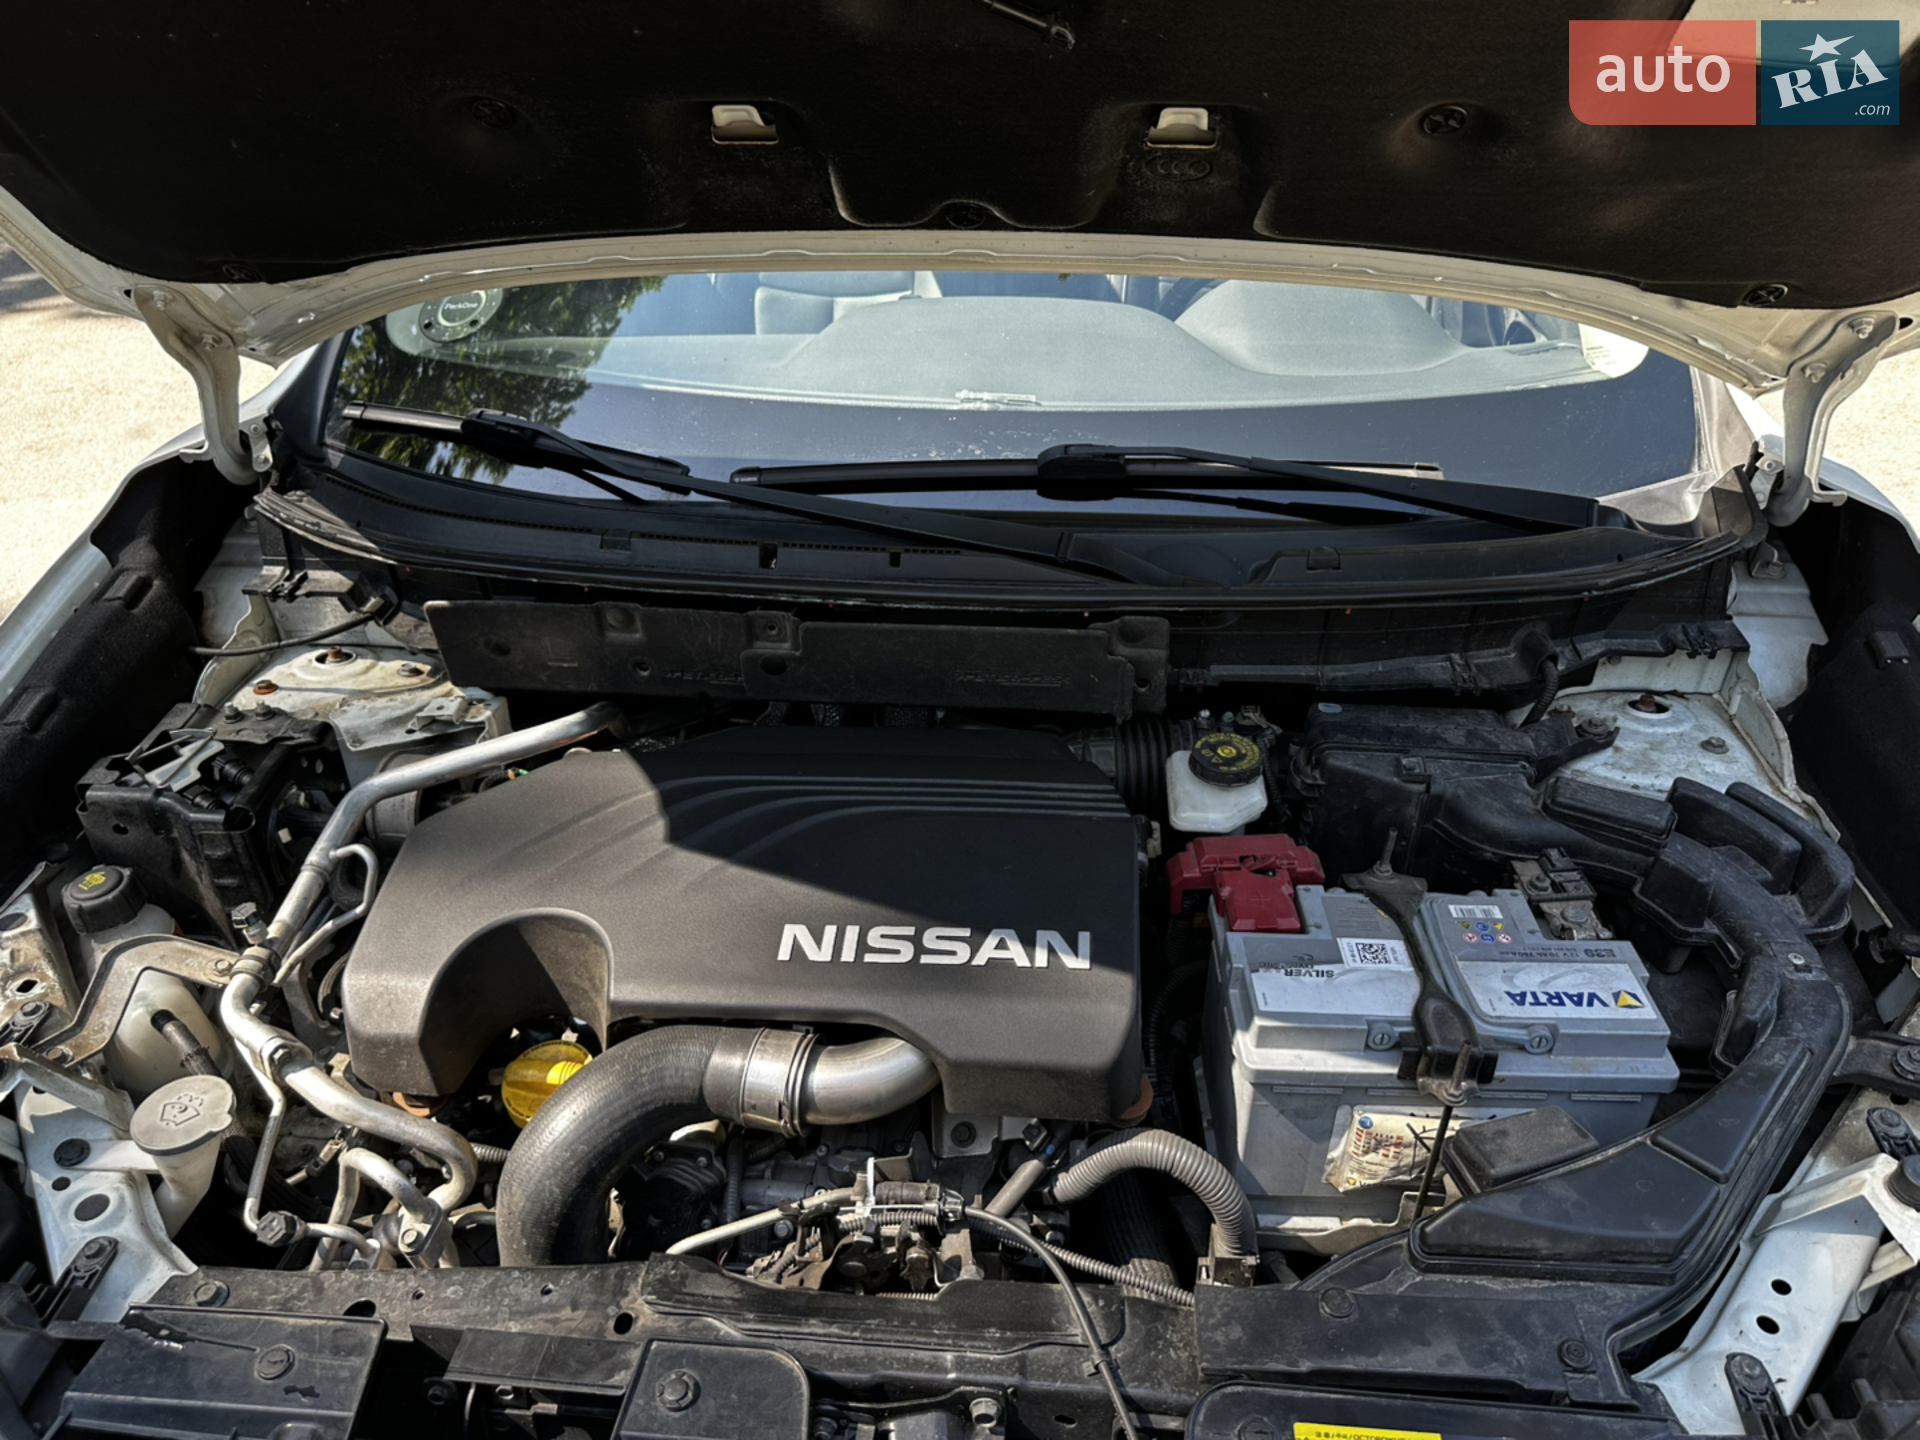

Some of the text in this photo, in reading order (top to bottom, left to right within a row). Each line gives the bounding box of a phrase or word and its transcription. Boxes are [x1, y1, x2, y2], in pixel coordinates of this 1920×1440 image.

[776, 923, 1091, 970] NISSAN
[1283, 968, 1335, 978] SILVER
[1504, 991, 1611, 1007] VARTA
